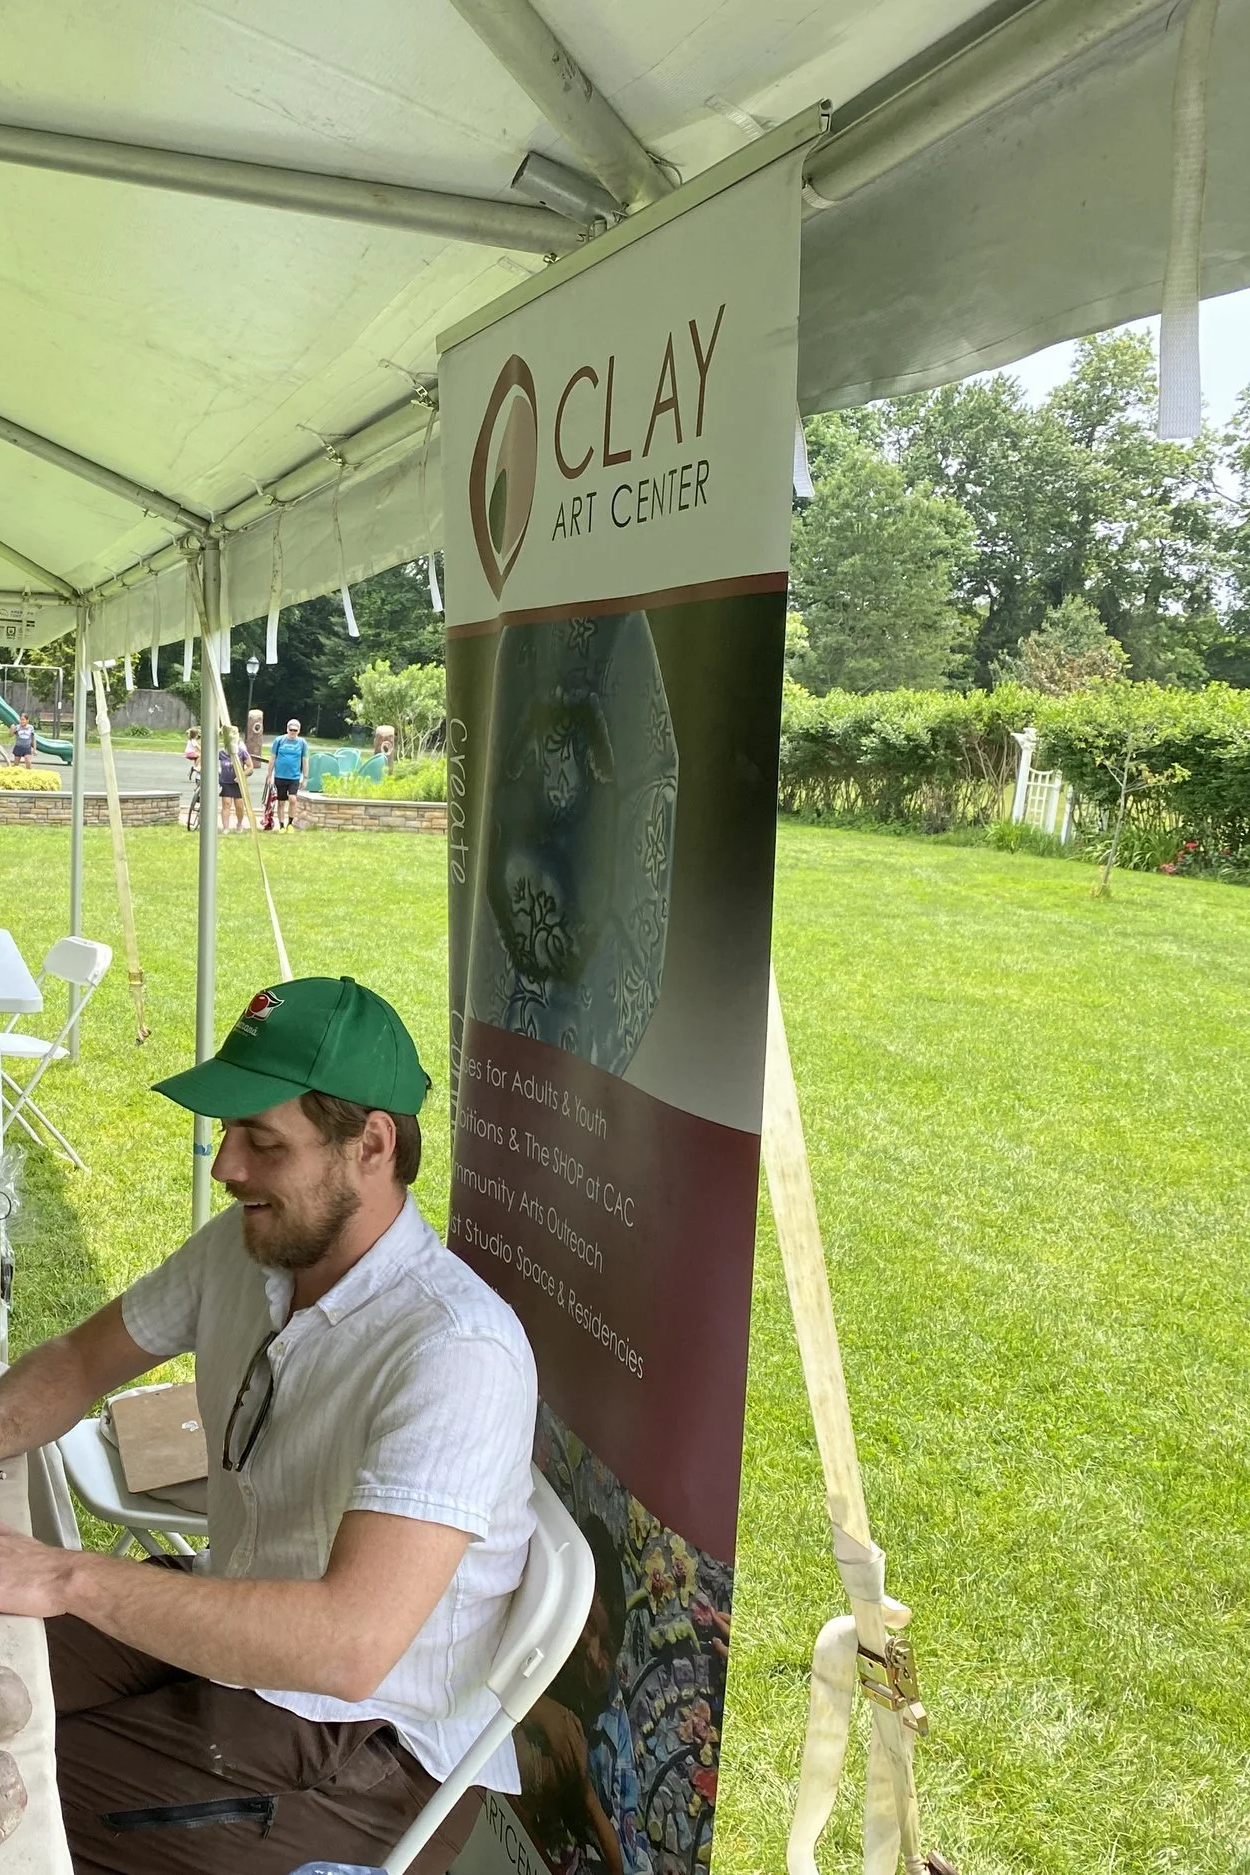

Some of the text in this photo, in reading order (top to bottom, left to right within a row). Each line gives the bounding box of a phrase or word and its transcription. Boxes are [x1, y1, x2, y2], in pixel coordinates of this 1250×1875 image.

[554, 304, 726, 480] CLAY
[551, 459, 710, 541] ART CENTER
[463, 1054, 608, 1141] ses for Adults & Youth
[453, 1158, 604, 1275] mmunity Arts Outreach
[459, 1105, 636, 1229] bitions & The SHOP at CAC
[464, 1217, 513, 1264] Studio
[516, 1244, 556, 1298] Space
[557, 1280, 566, 1308] &
[567, 1288, 645, 1380] Residencies
